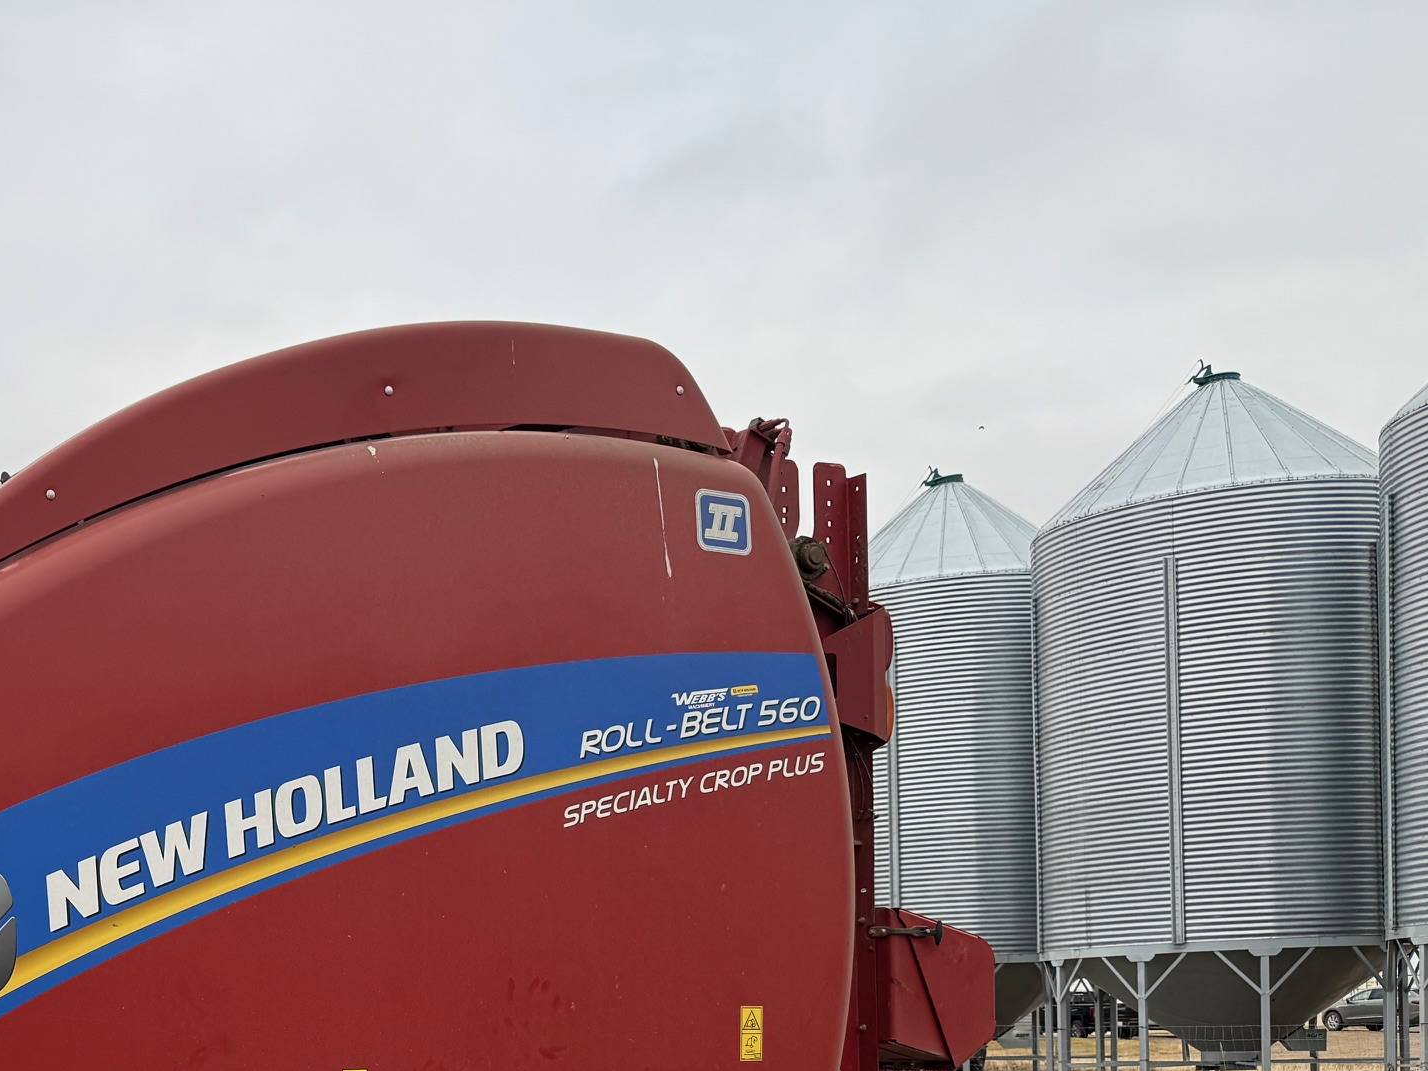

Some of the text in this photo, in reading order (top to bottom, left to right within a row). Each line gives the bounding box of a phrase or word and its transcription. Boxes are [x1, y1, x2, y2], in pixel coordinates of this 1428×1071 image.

[671, 687, 729, 706] WEBB'S
[758, 696, 821, 727] 560
[563, 752, 825, 828] SPECIALTY CROP PLUS
[44, 718, 525, 933] NEW HOLLAND
